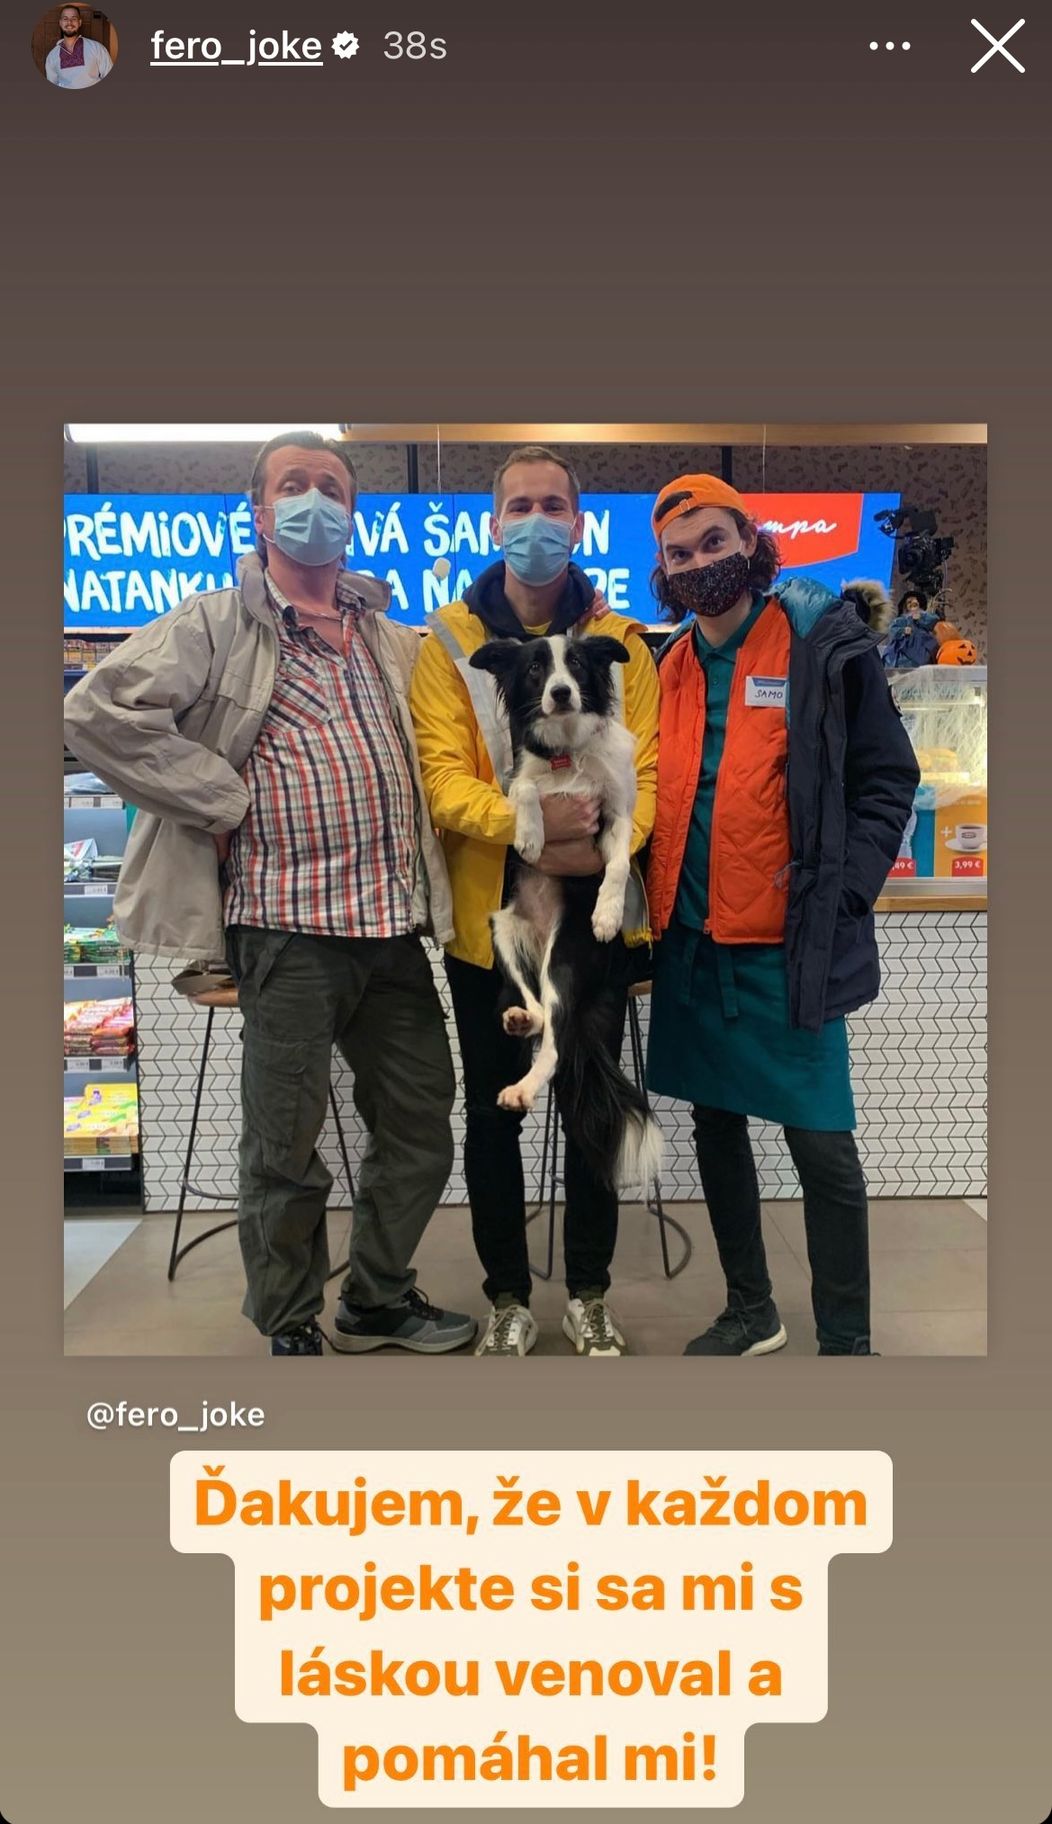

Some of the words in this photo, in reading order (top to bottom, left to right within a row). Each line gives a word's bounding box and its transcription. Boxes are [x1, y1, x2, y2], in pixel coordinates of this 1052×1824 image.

[64, 501, 256, 561] RÉMiOVÉ
[757, 519, 837, 540] mpa
[754, 689, 784, 700] SAMO
[955, 861, 973, 870] 3,99
